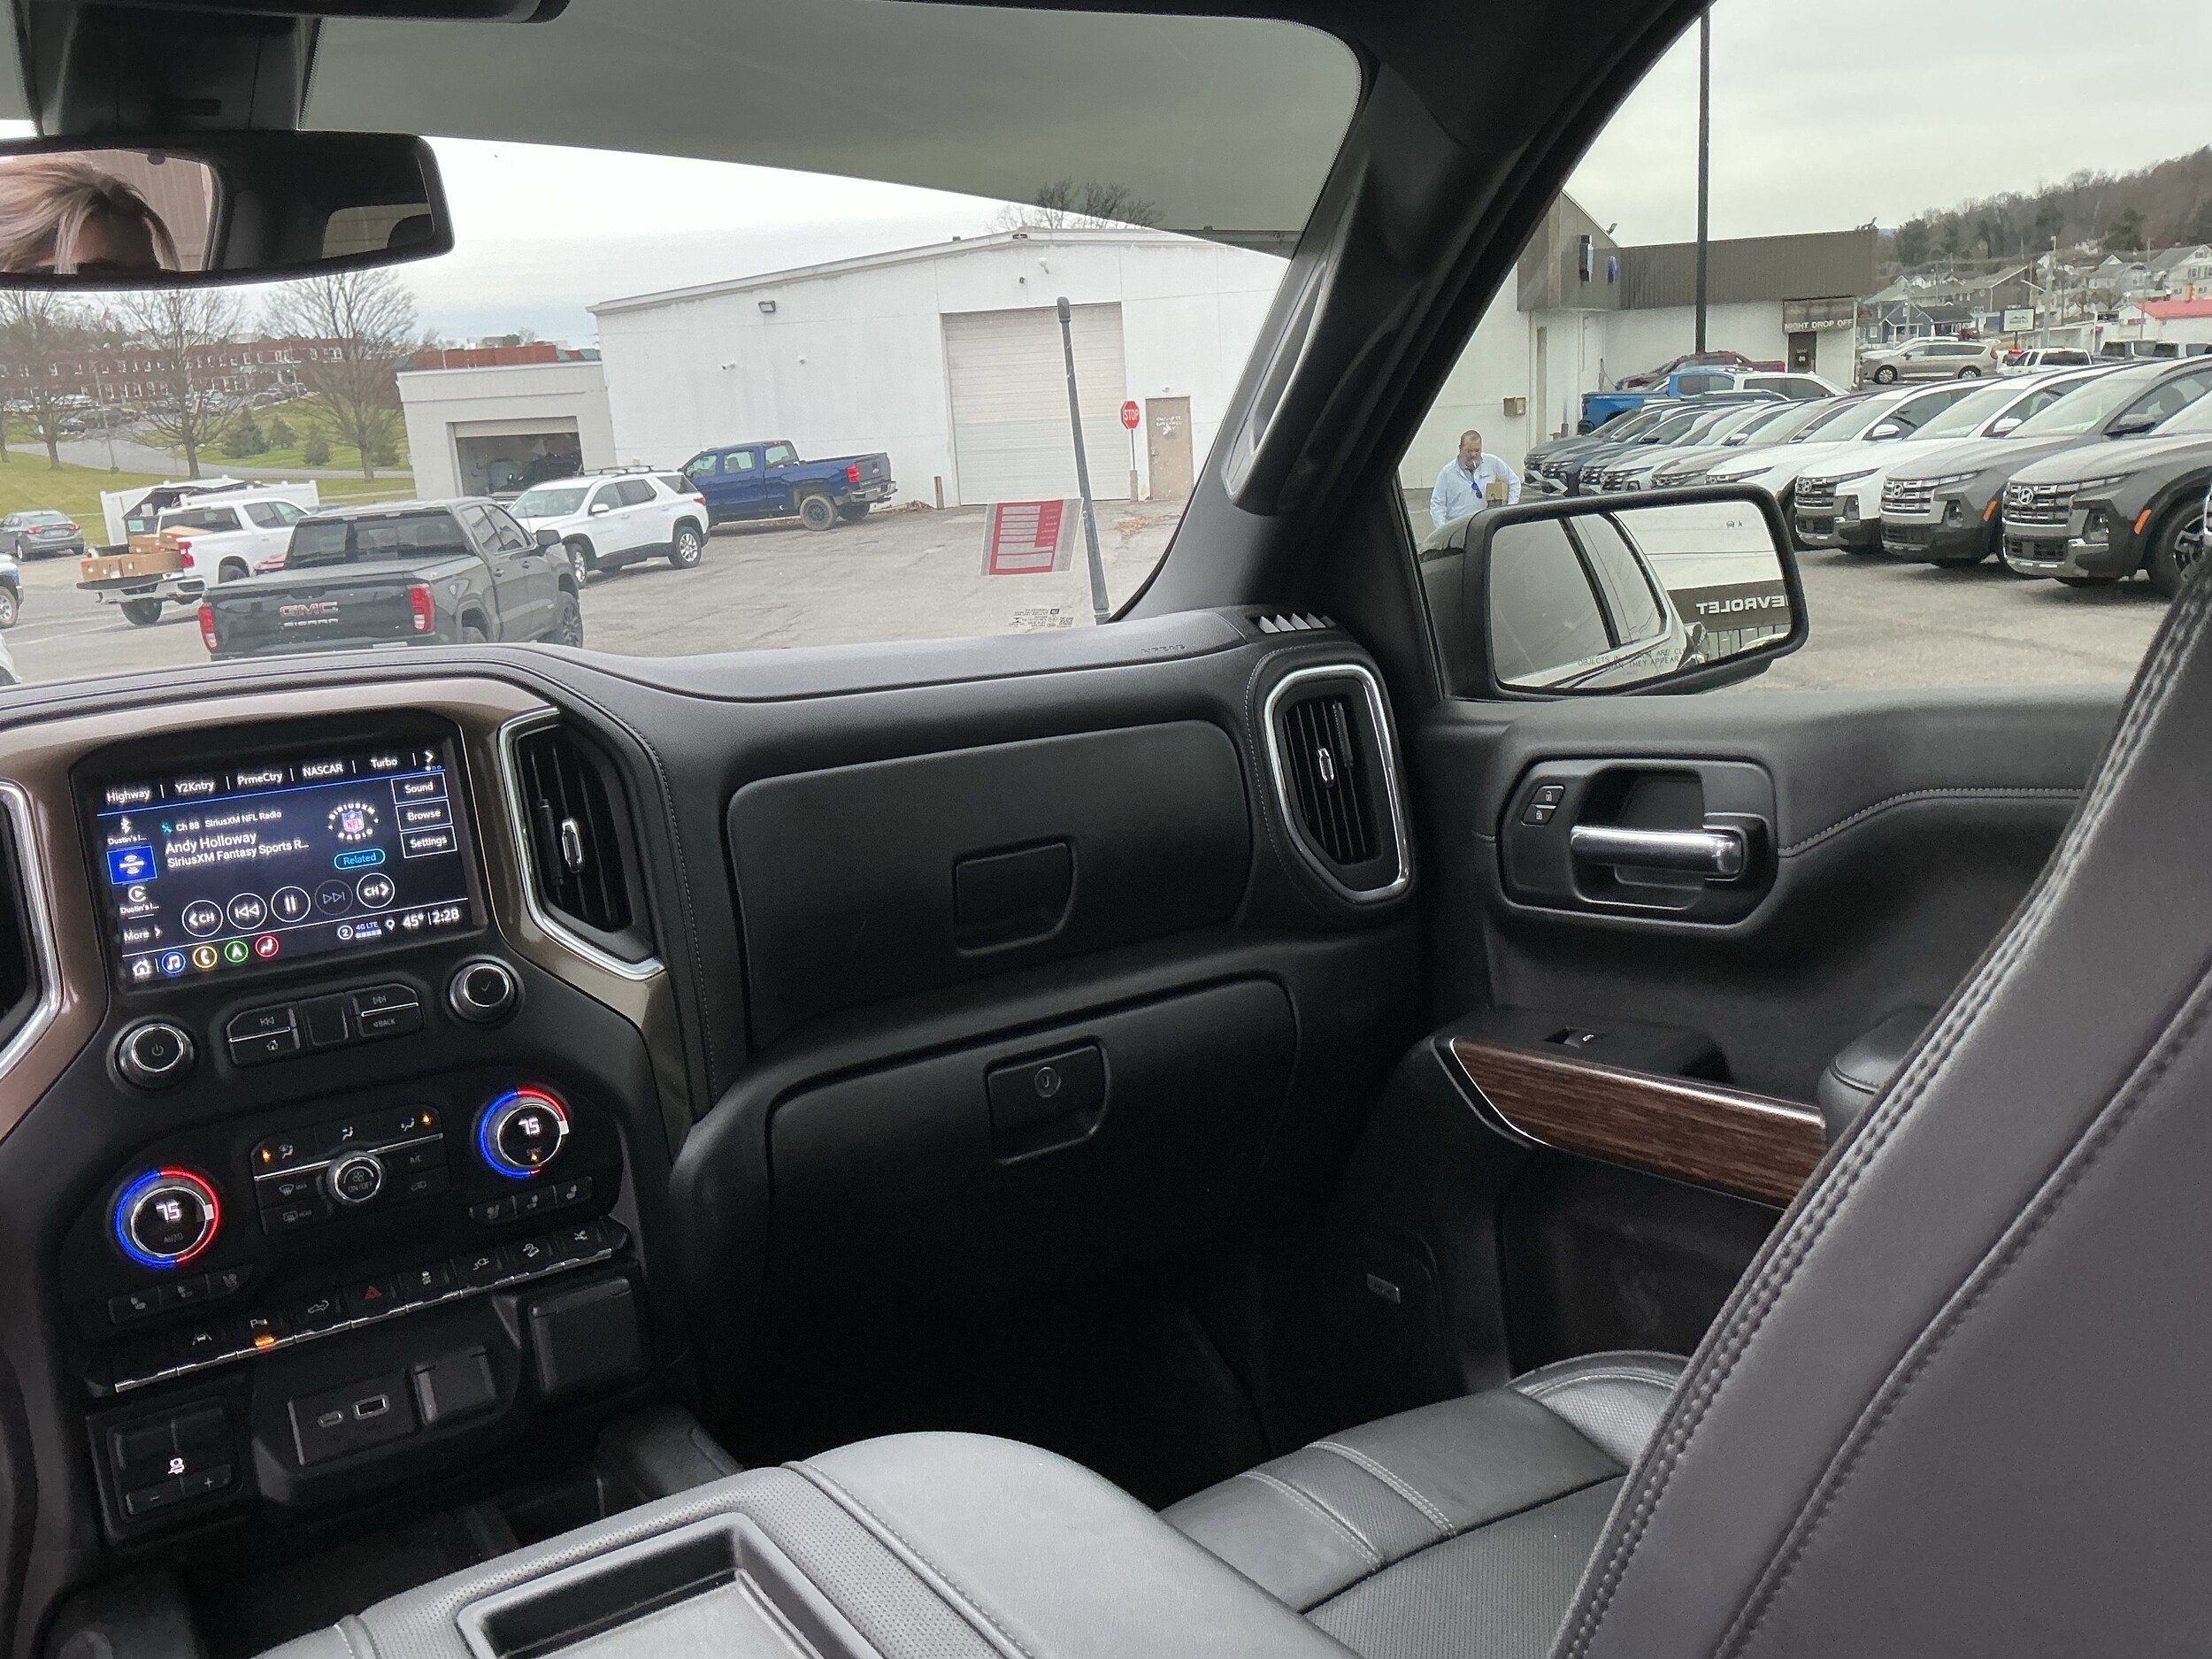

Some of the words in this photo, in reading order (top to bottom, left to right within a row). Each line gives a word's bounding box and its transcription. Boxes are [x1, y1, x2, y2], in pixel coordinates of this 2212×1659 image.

[1124, 409, 1138, 421] STOP
[280, 602, 339, 618] GMC
[1578, 656, 1610, 666] OBJECTS
[1650, 656, 1679, 665] APPEAR
[370, 757, 398, 769] Turbo
[303, 764, 344, 778] NASCAR
[237, 772, 283, 786] PrmeCtry
[175, 780, 215, 793] Y2Kntry
[404, 782, 434, 794] Sound
[106, 789, 150, 803] Highway
[328, 802, 376, 821] SIRIUSXM
[407, 809, 442, 821] Browse
[176, 823, 188, 832] Ch
[205, 816, 241, 828] SiriusXM
[242, 814, 258, 823] NFL
[259, 810, 282, 820] Radio
[107, 835, 137, 846] Dustin's
[337, 827, 373, 841] RADIO
[165, 840, 197, 856] Andy
[200, 832, 257, 850] Holloway
[410, 835, 448, 849] Settings
[167, 852, 215, 868] SiriusXM
[217, 847, 257, 861] Fantasy
[258, 841, 293, 856] Sports
[343, 852, 377, 865] Related
[364, 887, 379, 896] CH
[119, 903, 150, 914] Dustin's
[198, 912, 215, 923] CH
[403, 913, 425, 928] 45°
[432, 908, 460, 924] 2:28
[124, 930, 150, 941] More
[379, 1018, 396, 1027] BACK
[518, 1118, 540, 1135] 75
[410, 1154, 422, 1164] A/C
[348, 1181, 373, 1193] ON/OFF
[156, 1202, 181, 1221] 75
[164, 1233, 184, 1243] AUTO
